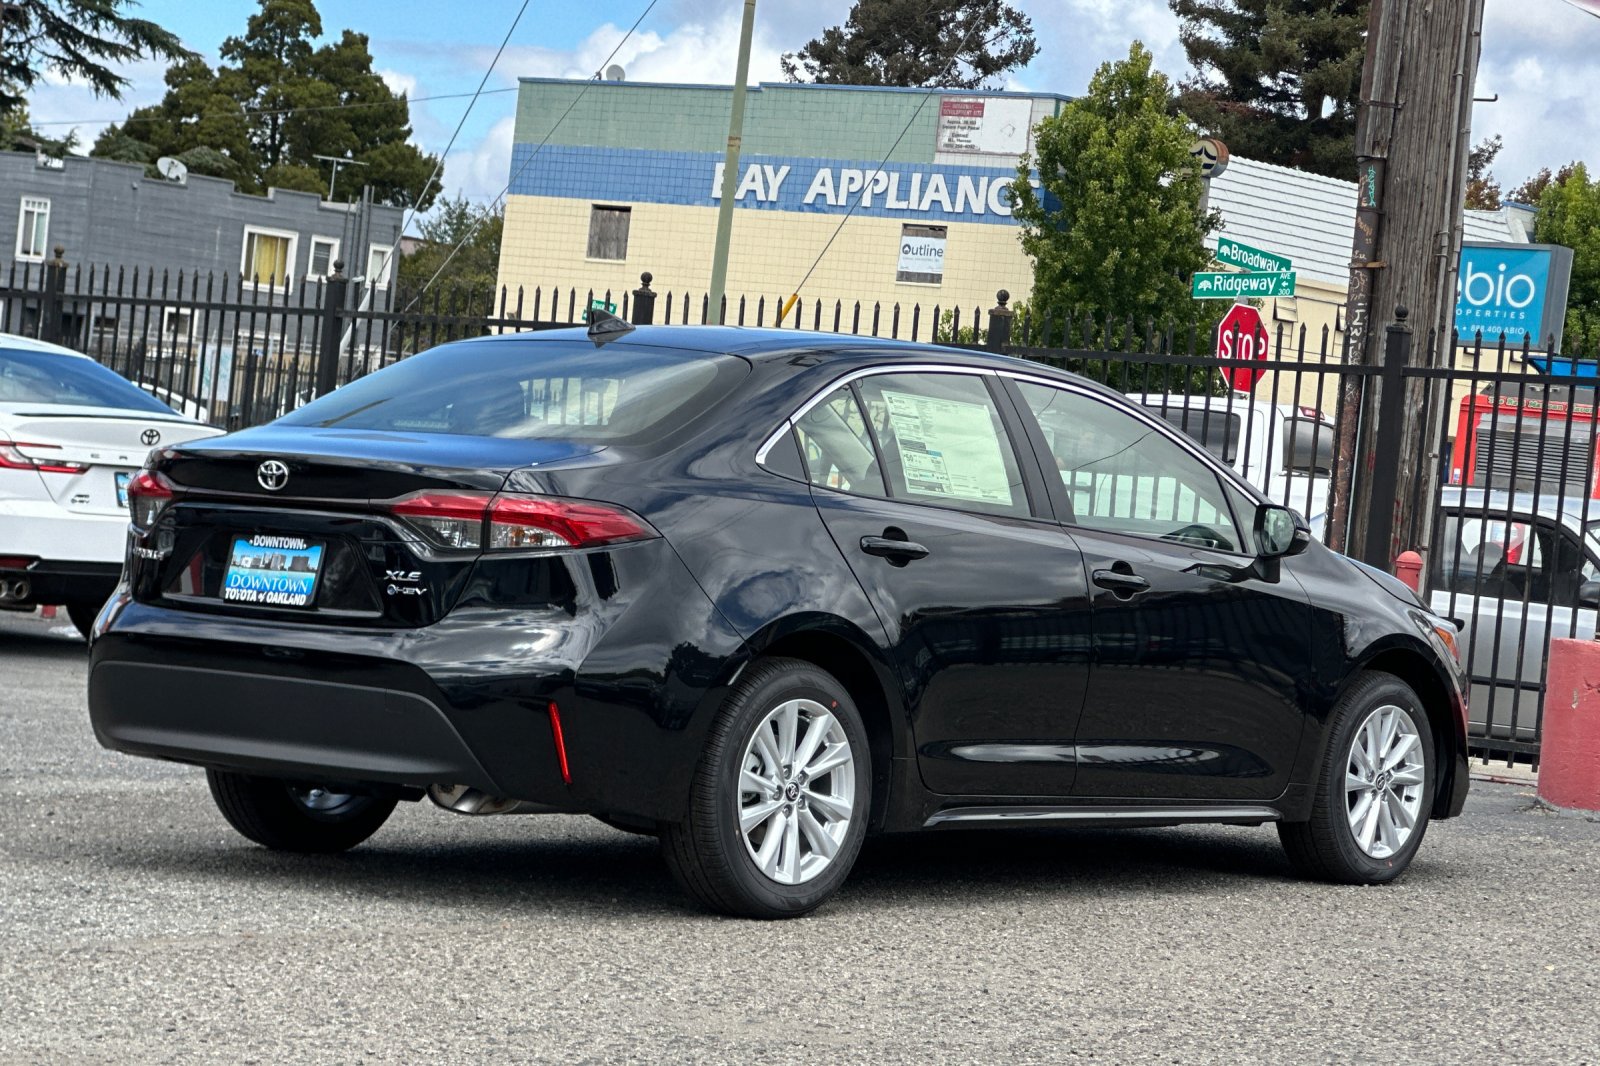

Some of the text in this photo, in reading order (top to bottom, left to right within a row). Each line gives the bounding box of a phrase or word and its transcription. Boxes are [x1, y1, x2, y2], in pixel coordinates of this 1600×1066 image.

[803, 167, 1040, 216] APPLIANC
[902, 243, 944, 258] Outline
[1231, 243, 1279, 272] Broadway
[1213, 272, 1291, 295] Ridgeway AVE
[1278, 288, 1291, 296] 300
[1457, 261, 1535, 308] bio
[1455, 308, 1525, 320] OPERTIES
[253, 535, 304, 550] DOWNTOWN
[230, 574, 309, 593] DOWNTOWN
[383, 570, 422, 581] XLE
[225, 587, 257, 601] TOYOTA
[266, 591, 307, 606] OAKLAND
